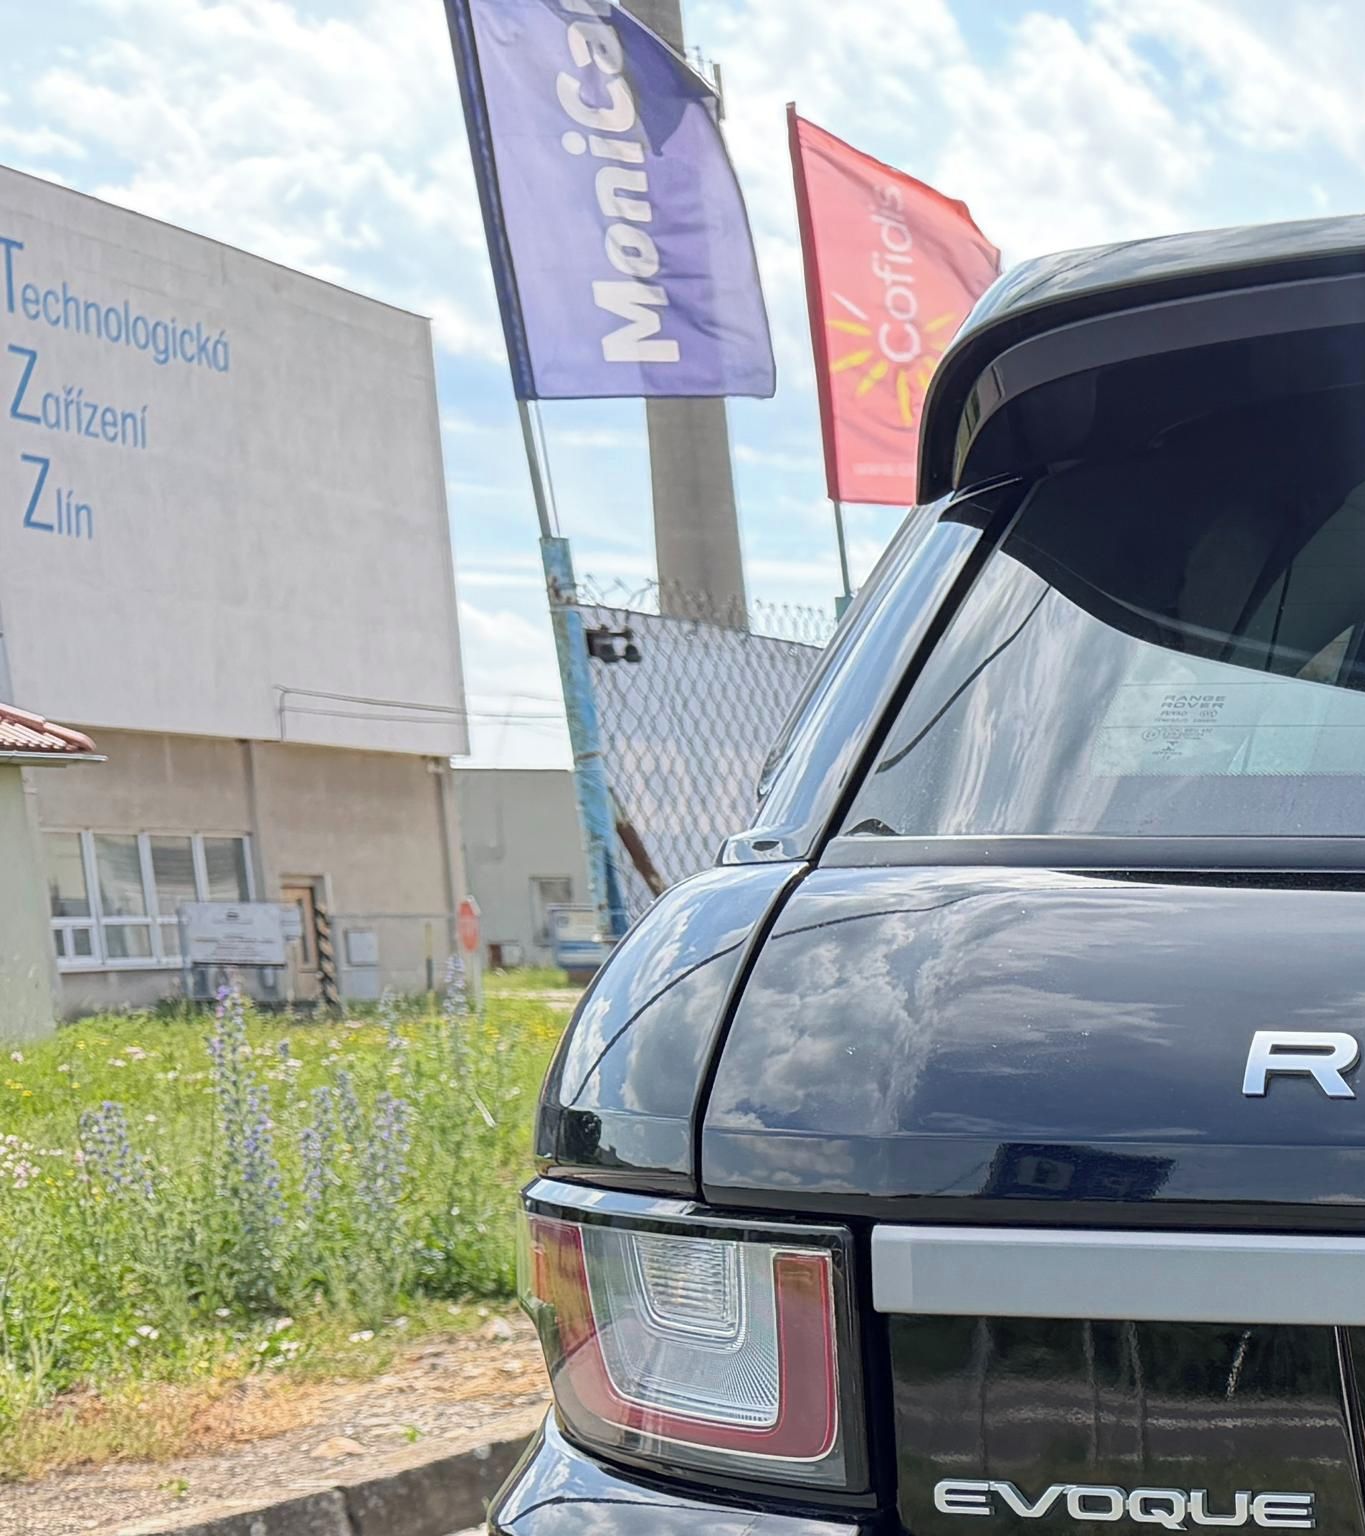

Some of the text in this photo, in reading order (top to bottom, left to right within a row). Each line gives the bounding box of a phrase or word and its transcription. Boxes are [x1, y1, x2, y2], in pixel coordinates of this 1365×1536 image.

[0, 236, 230, 373] Technologická
[871, 184, 922, 363] Cofidis
[8, 344, 148, 449] Zařízení
[21, 453, 93, 540] Zlín
[934, 1478, 1316, 1531] EVOQUE
